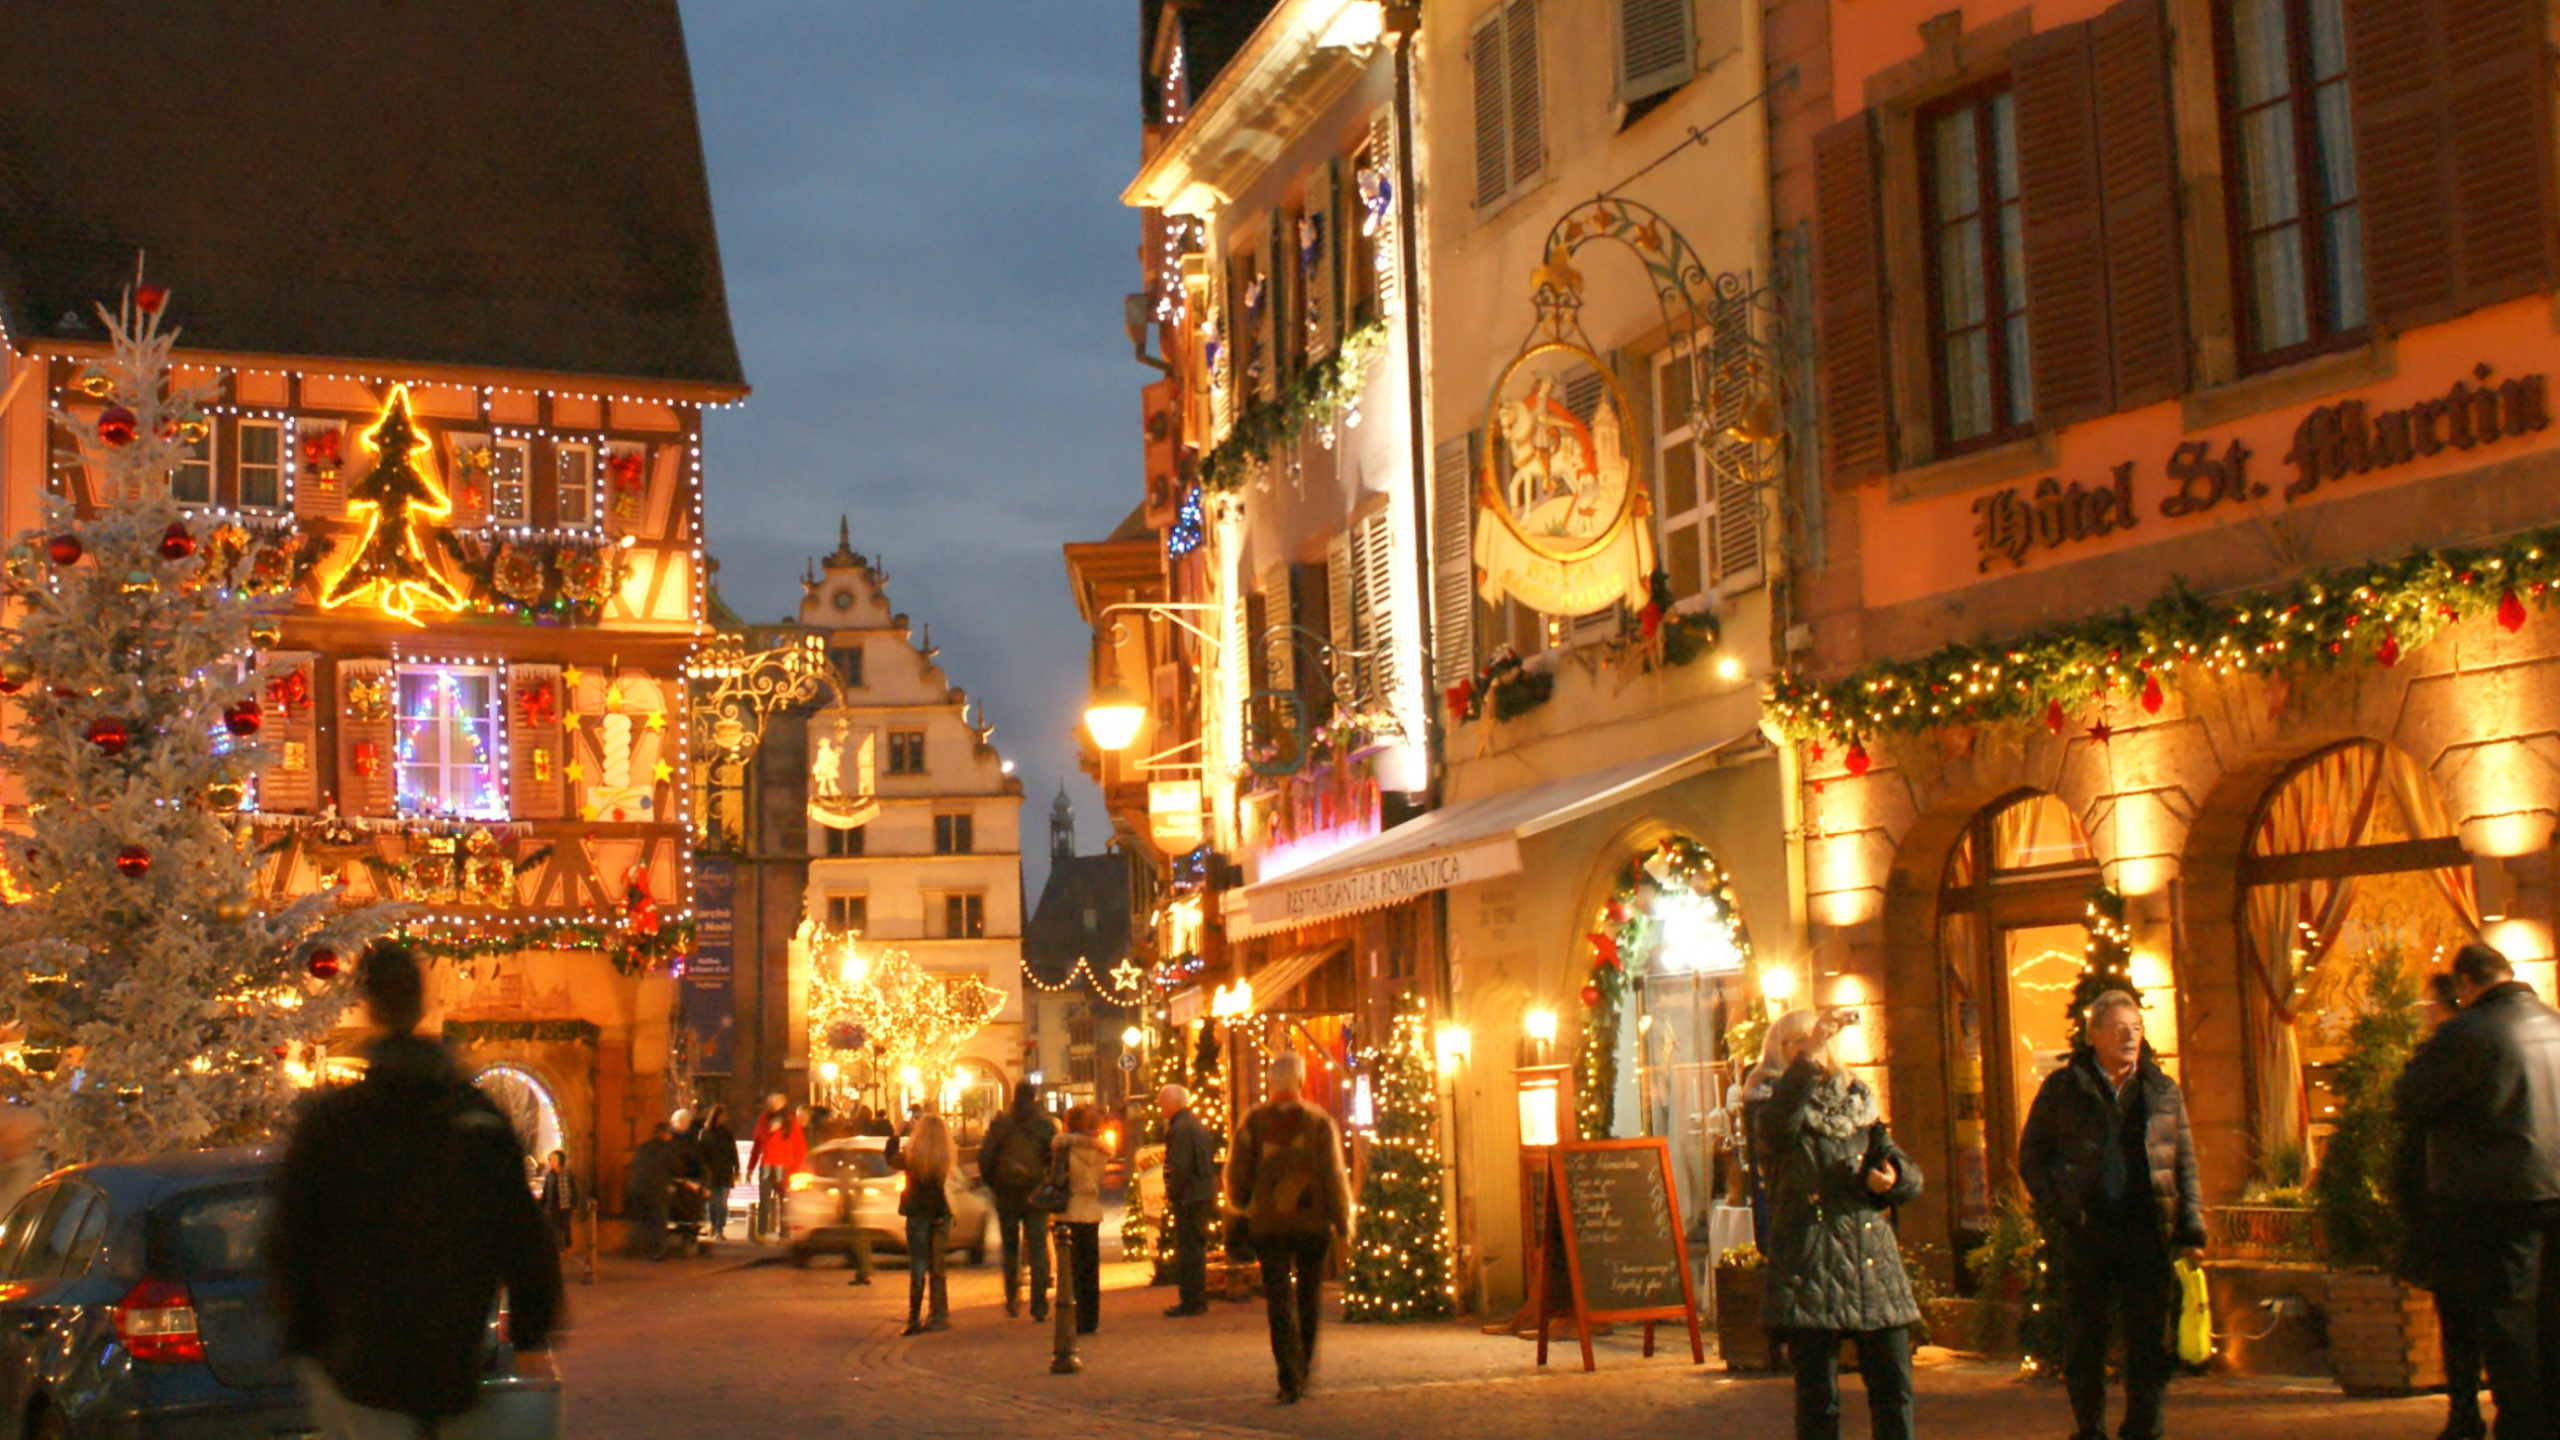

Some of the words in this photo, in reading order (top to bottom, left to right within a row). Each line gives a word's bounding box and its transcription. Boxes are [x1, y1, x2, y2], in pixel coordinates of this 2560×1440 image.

[1971, 460, 2138, 573] Hôtel
[2159, 438, 2270, 519] St.
[2284, 362, 2551, 505] Martin
[696, 908, 731, 919] arché
[1286, 878, 1357, 915] RESTAURANT
[1361, 875, 1376, 902] LA
[1380, 855, 1460, 897] ROMANTICA
